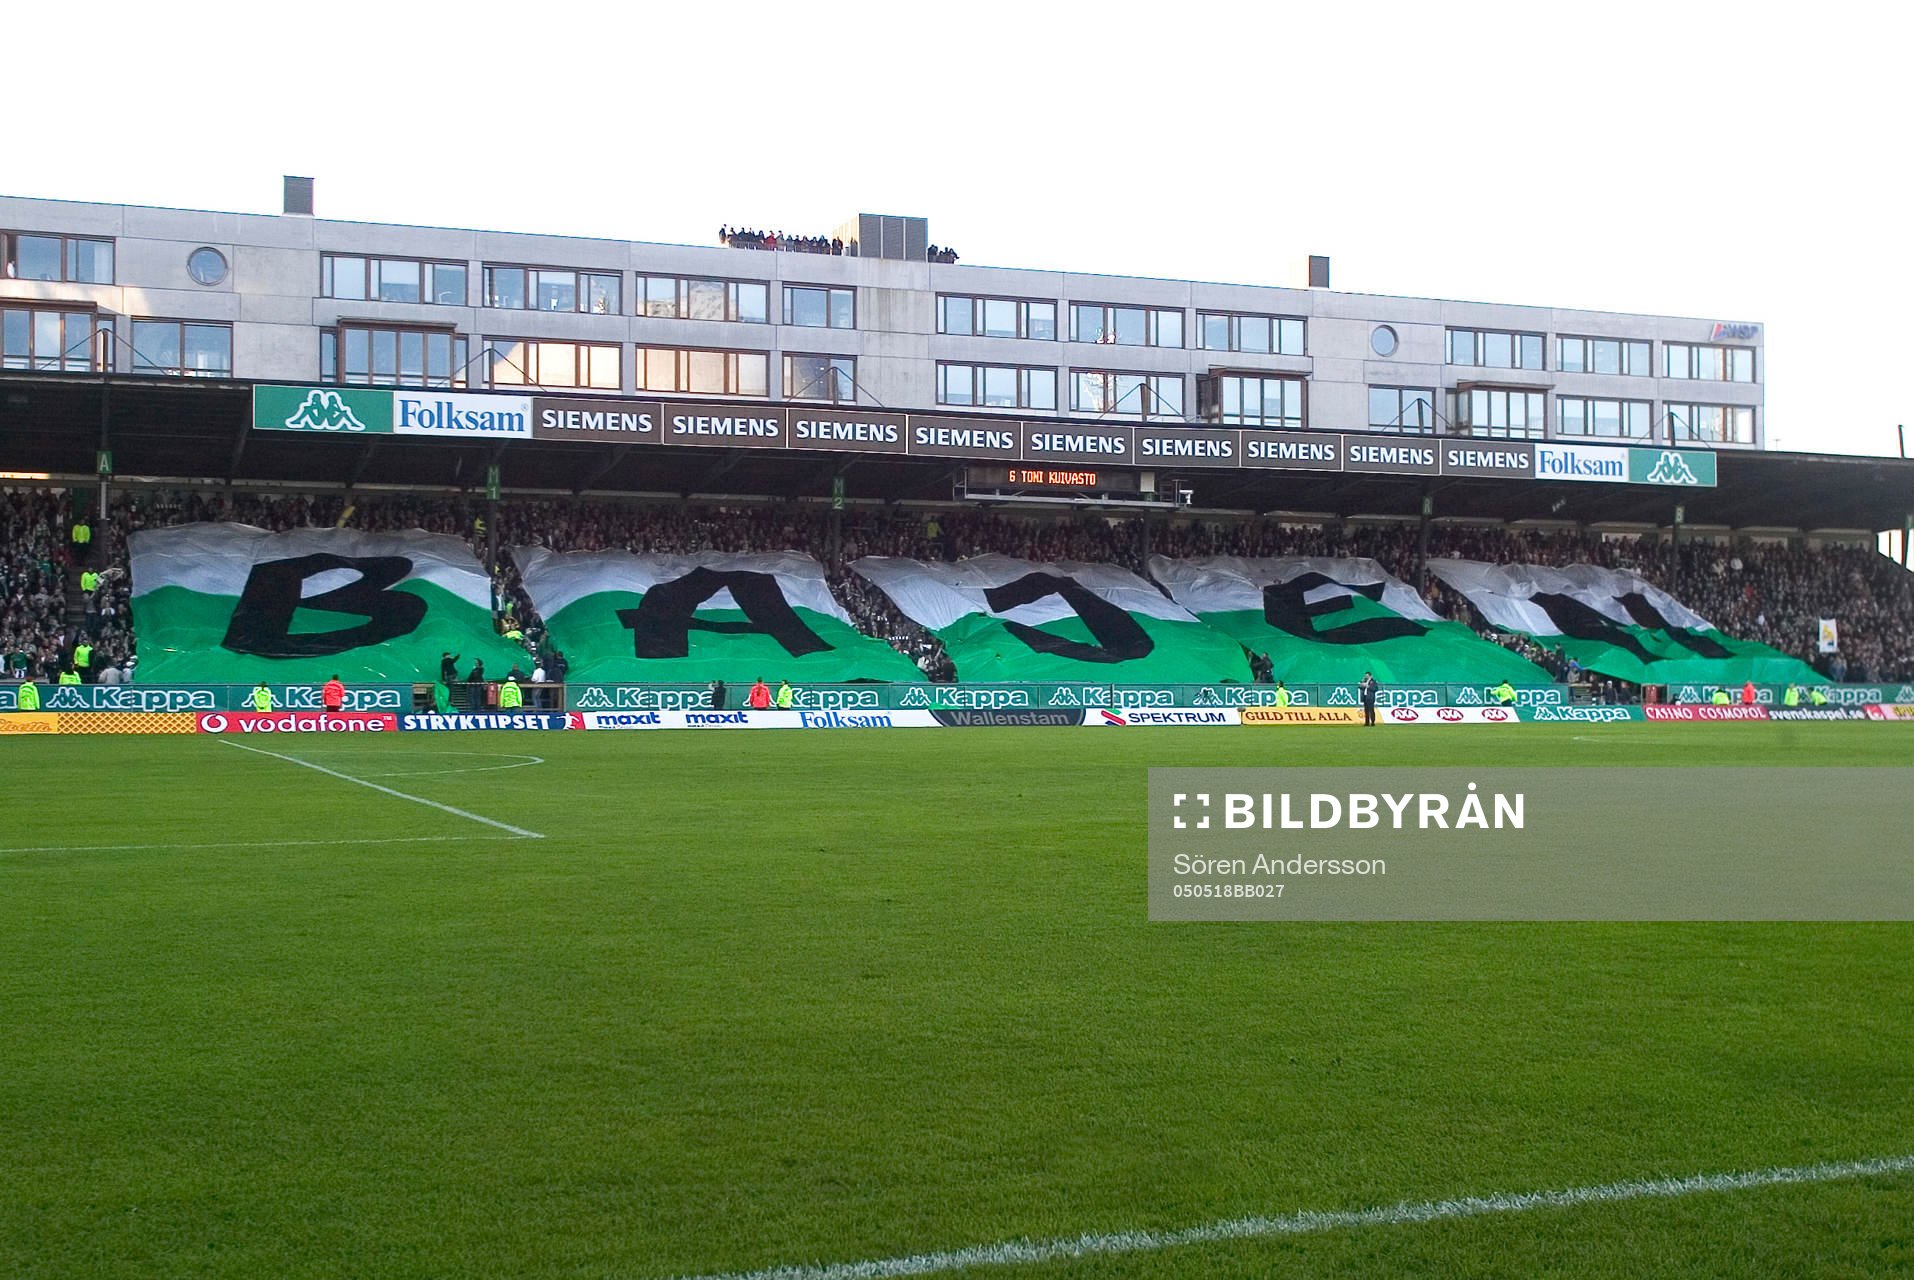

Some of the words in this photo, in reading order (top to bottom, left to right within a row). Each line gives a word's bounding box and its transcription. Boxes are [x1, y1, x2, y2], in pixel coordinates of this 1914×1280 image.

[398, 399, 525, 432] Folksam
[542, 409, 652, 432] SIEMENS
[672, 415, 779, 437] SIEMENS
[796, 420, 898, 443] SIEMENS
[915, 427, 1014, 449] SIEMENS
[1031, 433, 1126, 455] SIEMENS
[1142, 438, 1233, 458] SIEMENS
[1248, 440, 1335, 461] SIEMENS
[1350, 445, 1433, 466] SIEMENS
[1448, 449, 1529, 469] SIEMENS
[100, 453, 110, 472] A
[1539, 450, 1623, 477] Folksam
[1009, 470, 1016, 482] 6
[1048, 471, 1096, 486] KUIVASTO
[93, 687, 215, 712] Kappa
[936, 687, 1028, 709] Kappa
[1083, 688, 1174, 708] Kappa
[1226, 687, 1309, 707] Kapa
[1358, 688, 1438, 708] appa
[1484, 687, 1561, 707] Kppa
[239, 713, 384, 732] vodafone
[404, 714, 551, 730] STRYKTIPSET
[596, 711, 661, 725] maxit
[686, 711, 749, 724] maxit
[799, 711, 892, 728] Folksam
[950, 711, 1069, 725] Wallenstam
[1128, 712, 1226, 723] SPEKTRUM
[1245, 711, 1284, 721] GULD
[1286, 711, 1316, 721] TILL
[1318, 712, 1352, 722] ALLA
[1393, 708, 1417, 720] AXA
[1440, 708, 1463, 720] AXA
[1485, 708, 1507, 720] AXA
[1557, 706, 1631, 722] Kappa
[1645, 707, 1693, 719] CASINO
[1698, 707, 1767, 719] COSMOPOL
[1769, 707, 1865, 721] svenskaspel.se
